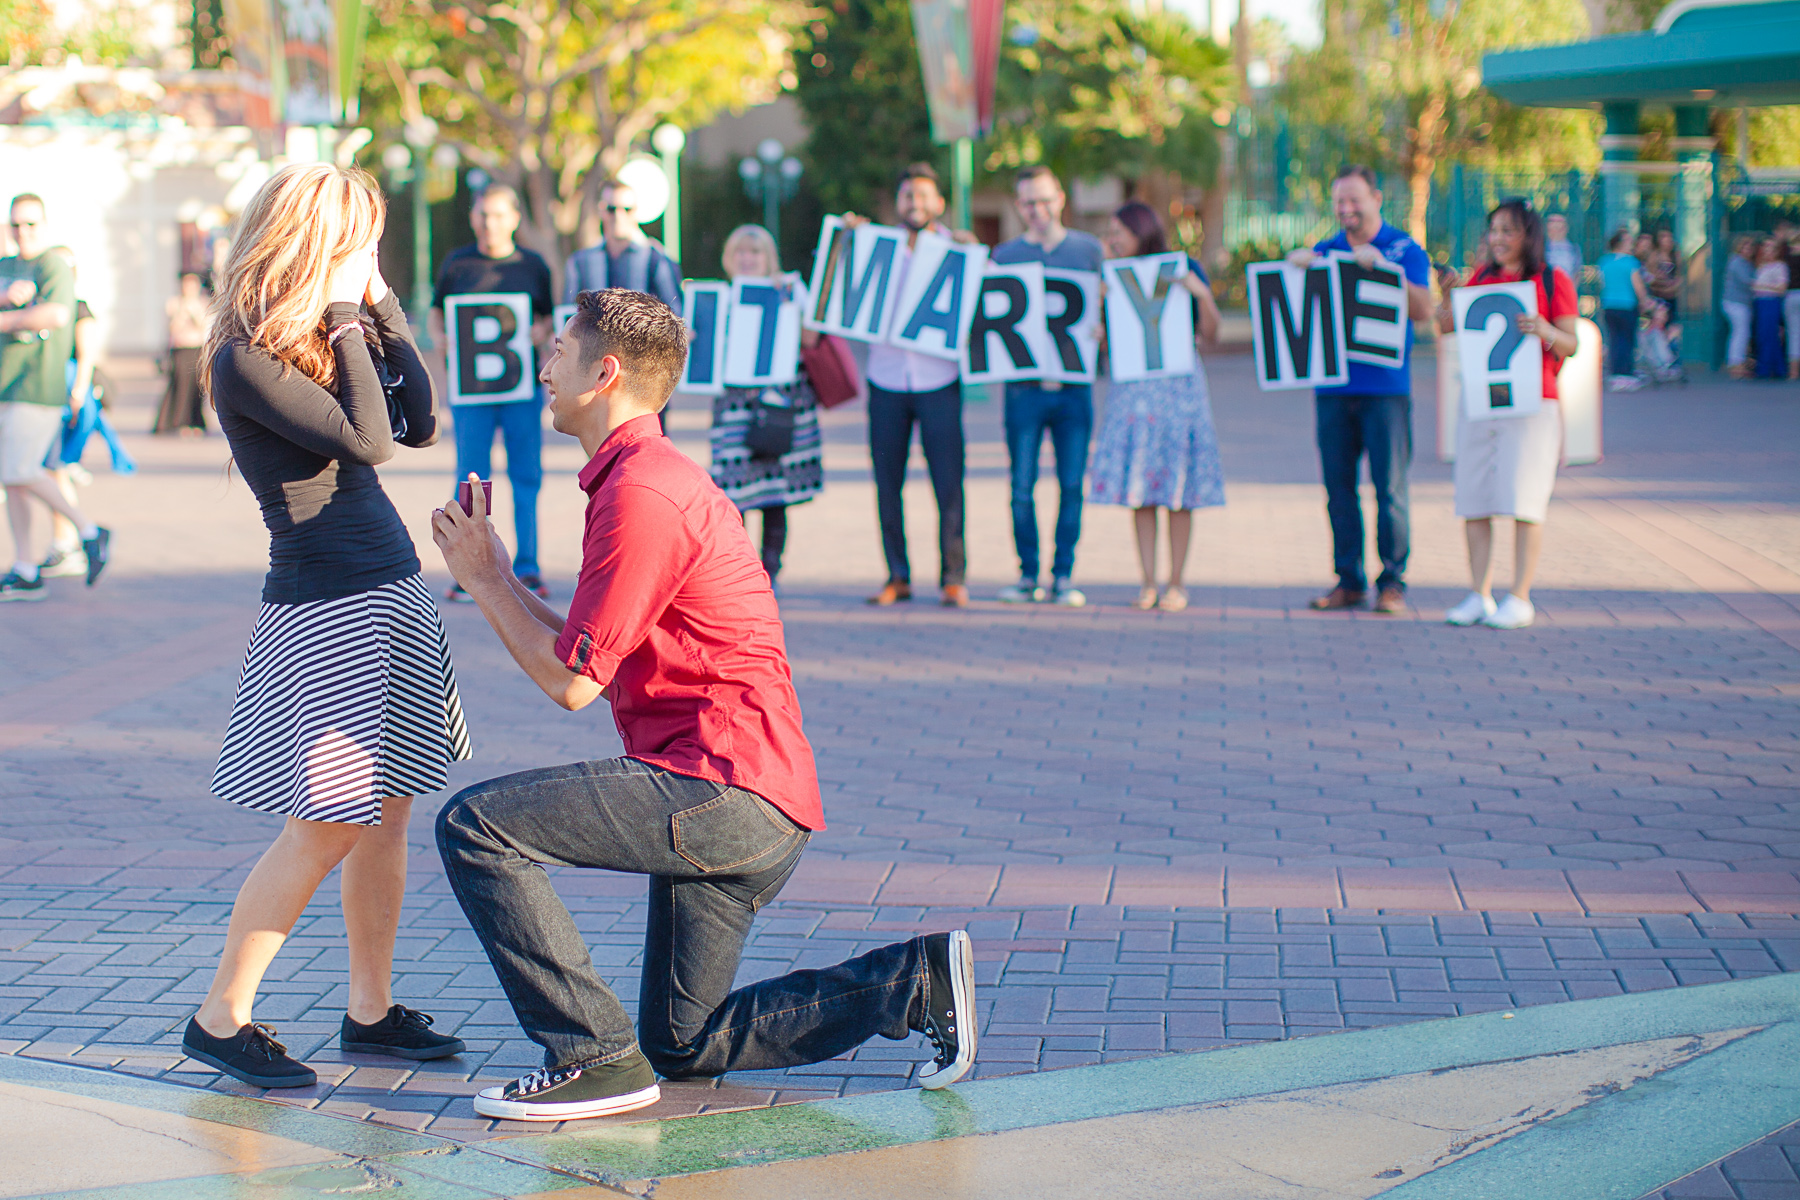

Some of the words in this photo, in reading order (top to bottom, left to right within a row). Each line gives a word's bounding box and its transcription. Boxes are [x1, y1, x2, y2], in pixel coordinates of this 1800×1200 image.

[814, 226, 1178, 374] MARRY
[1256, 259, 1401, 381] ME
[1464, 293, 1528, 408] ?
